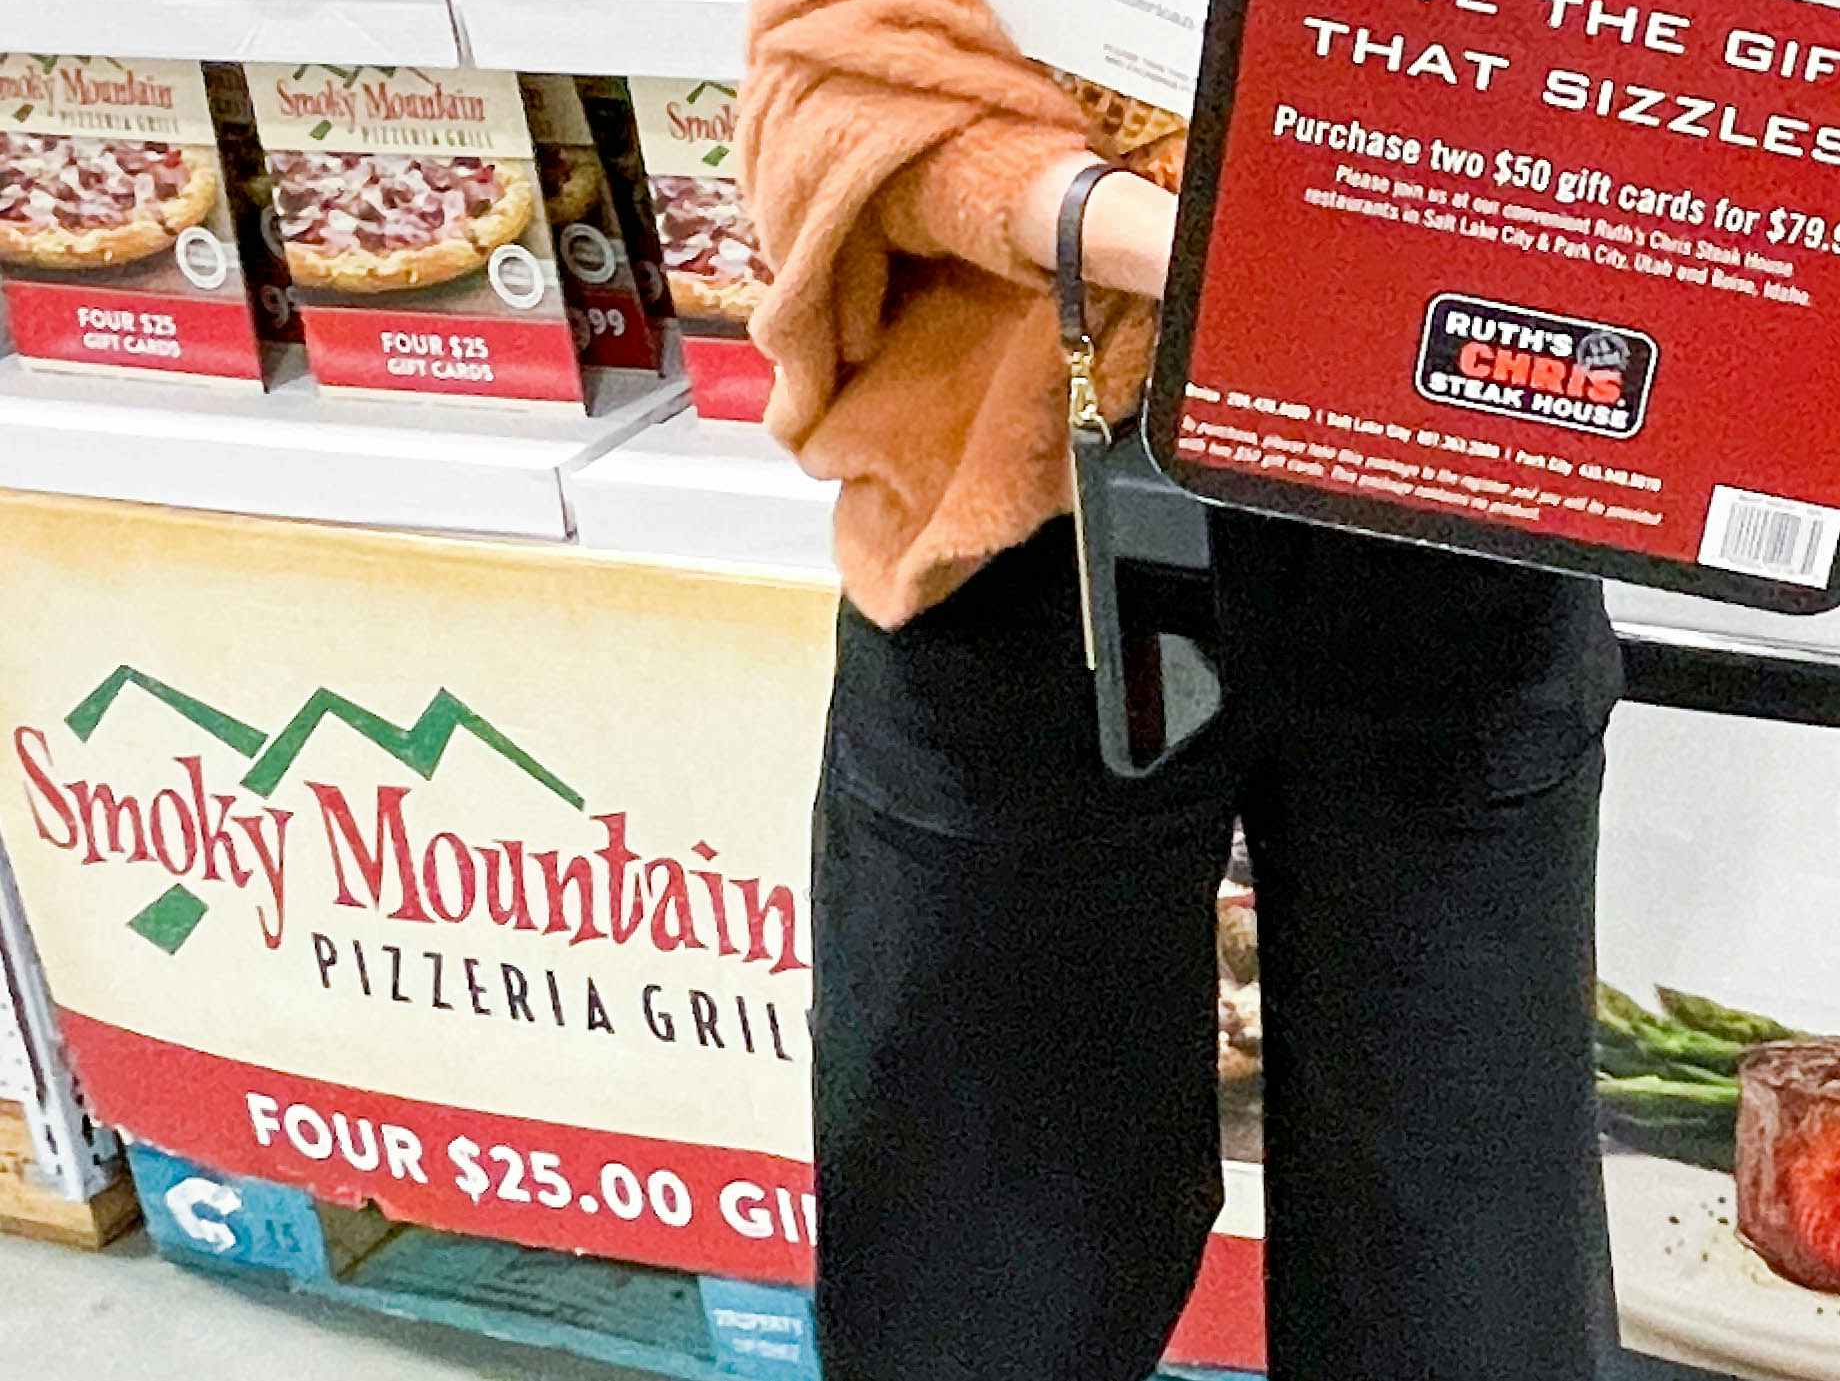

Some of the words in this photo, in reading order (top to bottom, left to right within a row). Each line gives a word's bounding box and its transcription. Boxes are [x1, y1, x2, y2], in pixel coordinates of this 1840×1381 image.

[1303, 16, 1510, 92] THAT
[275, 78, 360, 132] Smoky
[365, 81, 484, 125] Mountain
[1273, 104, 1422, 165] Purchase
[1430, 140, 1484, 178] two
[1492, 149, 1552, 192] $50
[1556, 171, 1612, 213] gift
[1618, 181, 1705, 225] cards
[1713, 198, 1761, 236] for
[77, 306, 135, 335] FOUR
[141, 311, 177, 336] $25
[82, 330, 121, 353] GIFT
[124, 333, 181, 359] CARDS
[381, 331, 444, 357] FOUR
[449, 334, 489, 359] $25
[1446, 310, 1573, 357] RUTH'S
[386, 356, 427, 378] GIFT
[432, 359, 494, 383] CARDS
[1459, 340, 1622, 405] CHRIS
[1428, 371, 1524, 408] STEAK
[1531, 392, 1629, 429] HOUSE
[13, 725, 293, 950] Smoky
[305, 780, 814, 975] Mountain
[311, 932, 616, 1034] PIZZERIA
[245, 1091, 427, 1185] FOUR
[447, 1134, 693, 1228] $25.00
